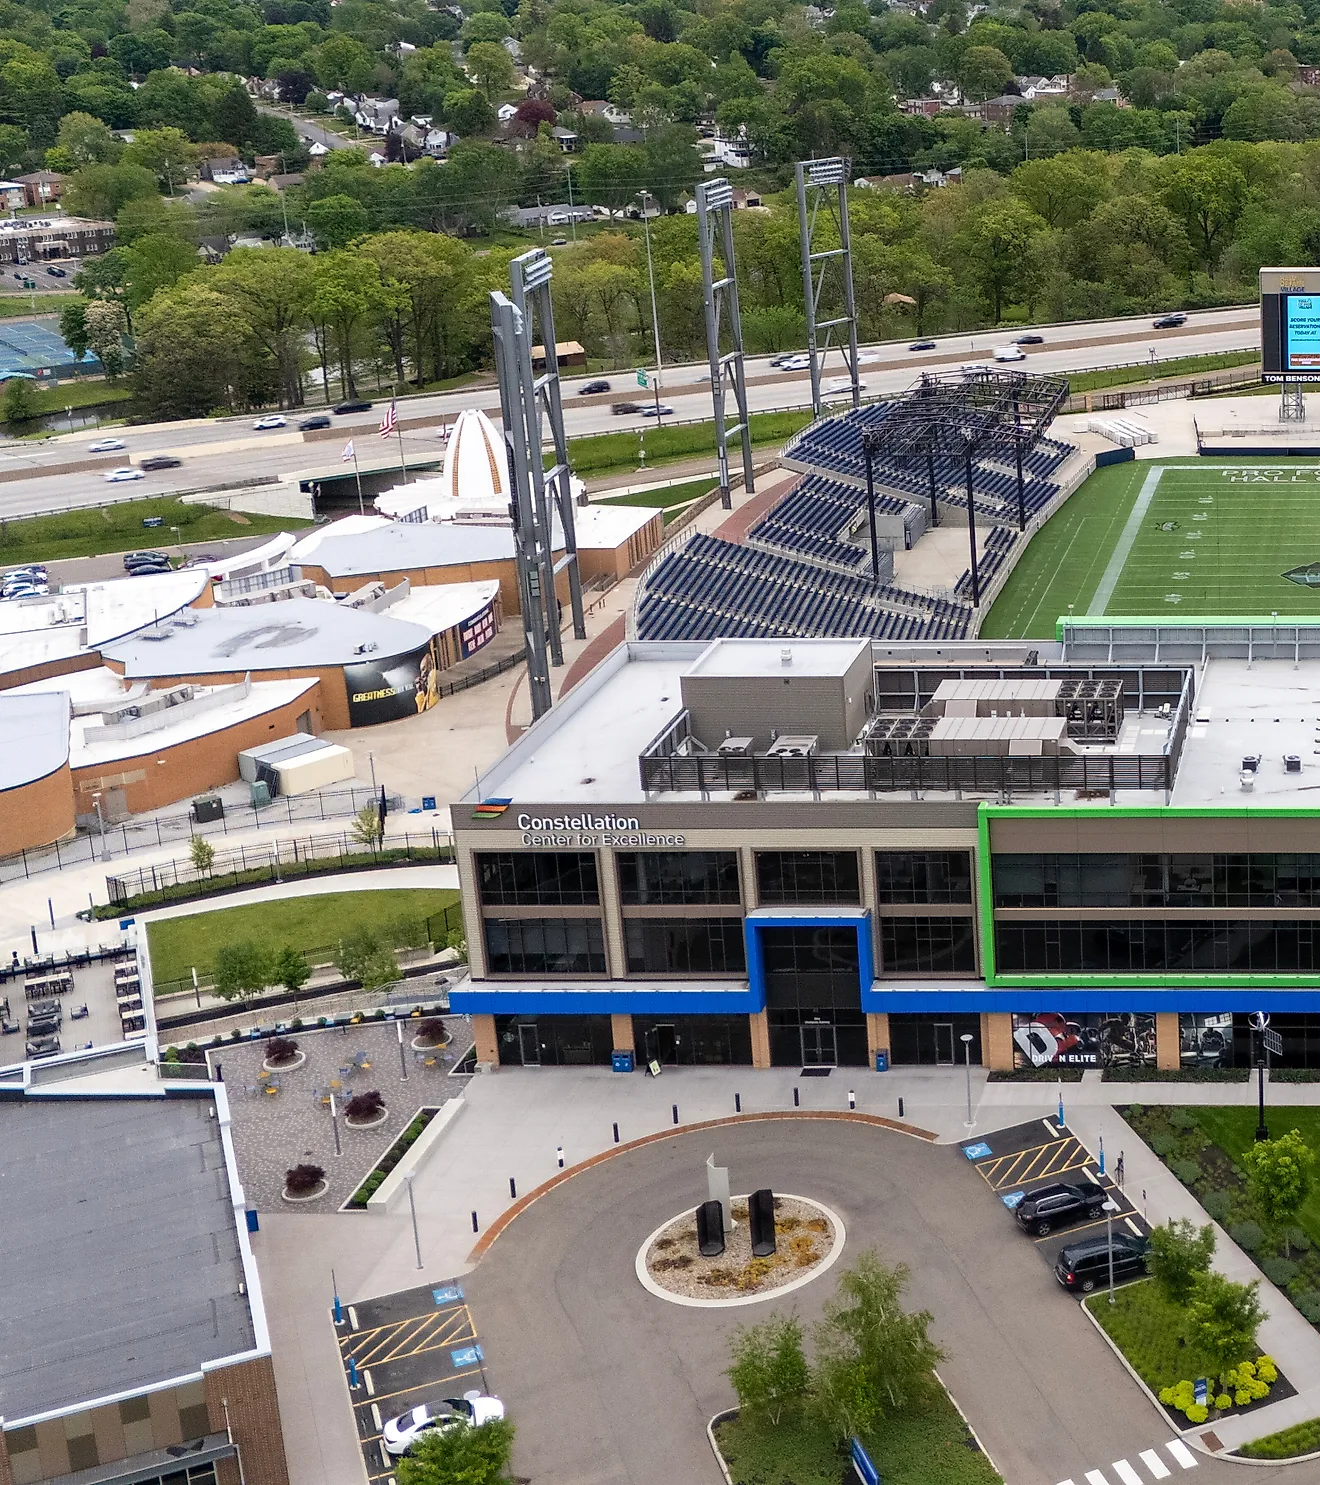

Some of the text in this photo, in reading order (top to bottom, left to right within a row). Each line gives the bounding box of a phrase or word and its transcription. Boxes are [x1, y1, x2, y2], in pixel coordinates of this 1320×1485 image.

[353, 688, 396, 702] GREATNESS
[518, 813, 639, 830] Constellation
[522, 833, 685, 846] Center for Excellence
[1032, 1054, 1096, 1062] DRIVN ELITE
